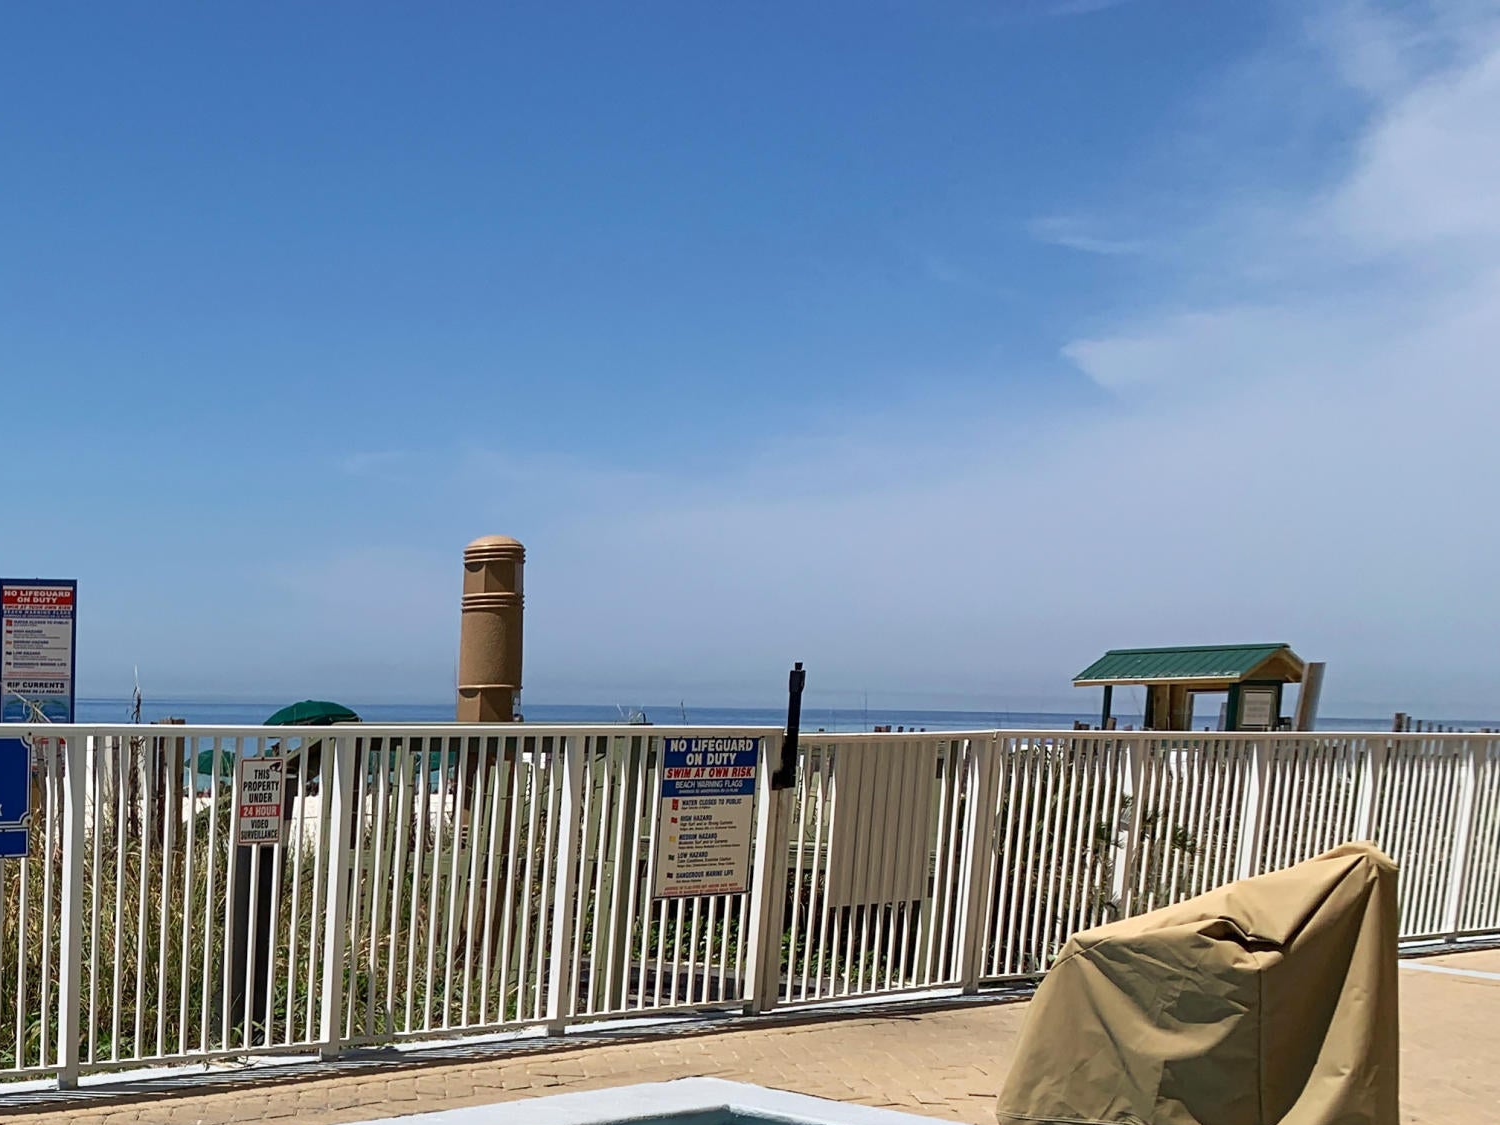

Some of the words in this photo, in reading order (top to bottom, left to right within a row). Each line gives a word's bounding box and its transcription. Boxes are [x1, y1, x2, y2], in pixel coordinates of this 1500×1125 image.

[670, 740, 687, 752] NO
[692, 739, 753, 752] LIFEGUARD
[686, 753, 702, 765] ON
[707, 753, 736, 765] DUTY
[254, 769, 270, 780] THIS
[667, 768, 691, 778] SWIM
[694, 768, 706, 778] AT
[709, 768, 728, 777] OWN
[732, 767, 752, 777] RISK
[243, 781, 279, 791] PROPERTY
[697, 780, 723, 788] WARNING
[249, 793, 272, 803] UNDER
[244, 807, 253, 816] 24
[256, 806, 276, 815] HOUR
[251, 819, 268, 828] VIDEO
[241, 830, 278, 840] SURVEILLANCE
